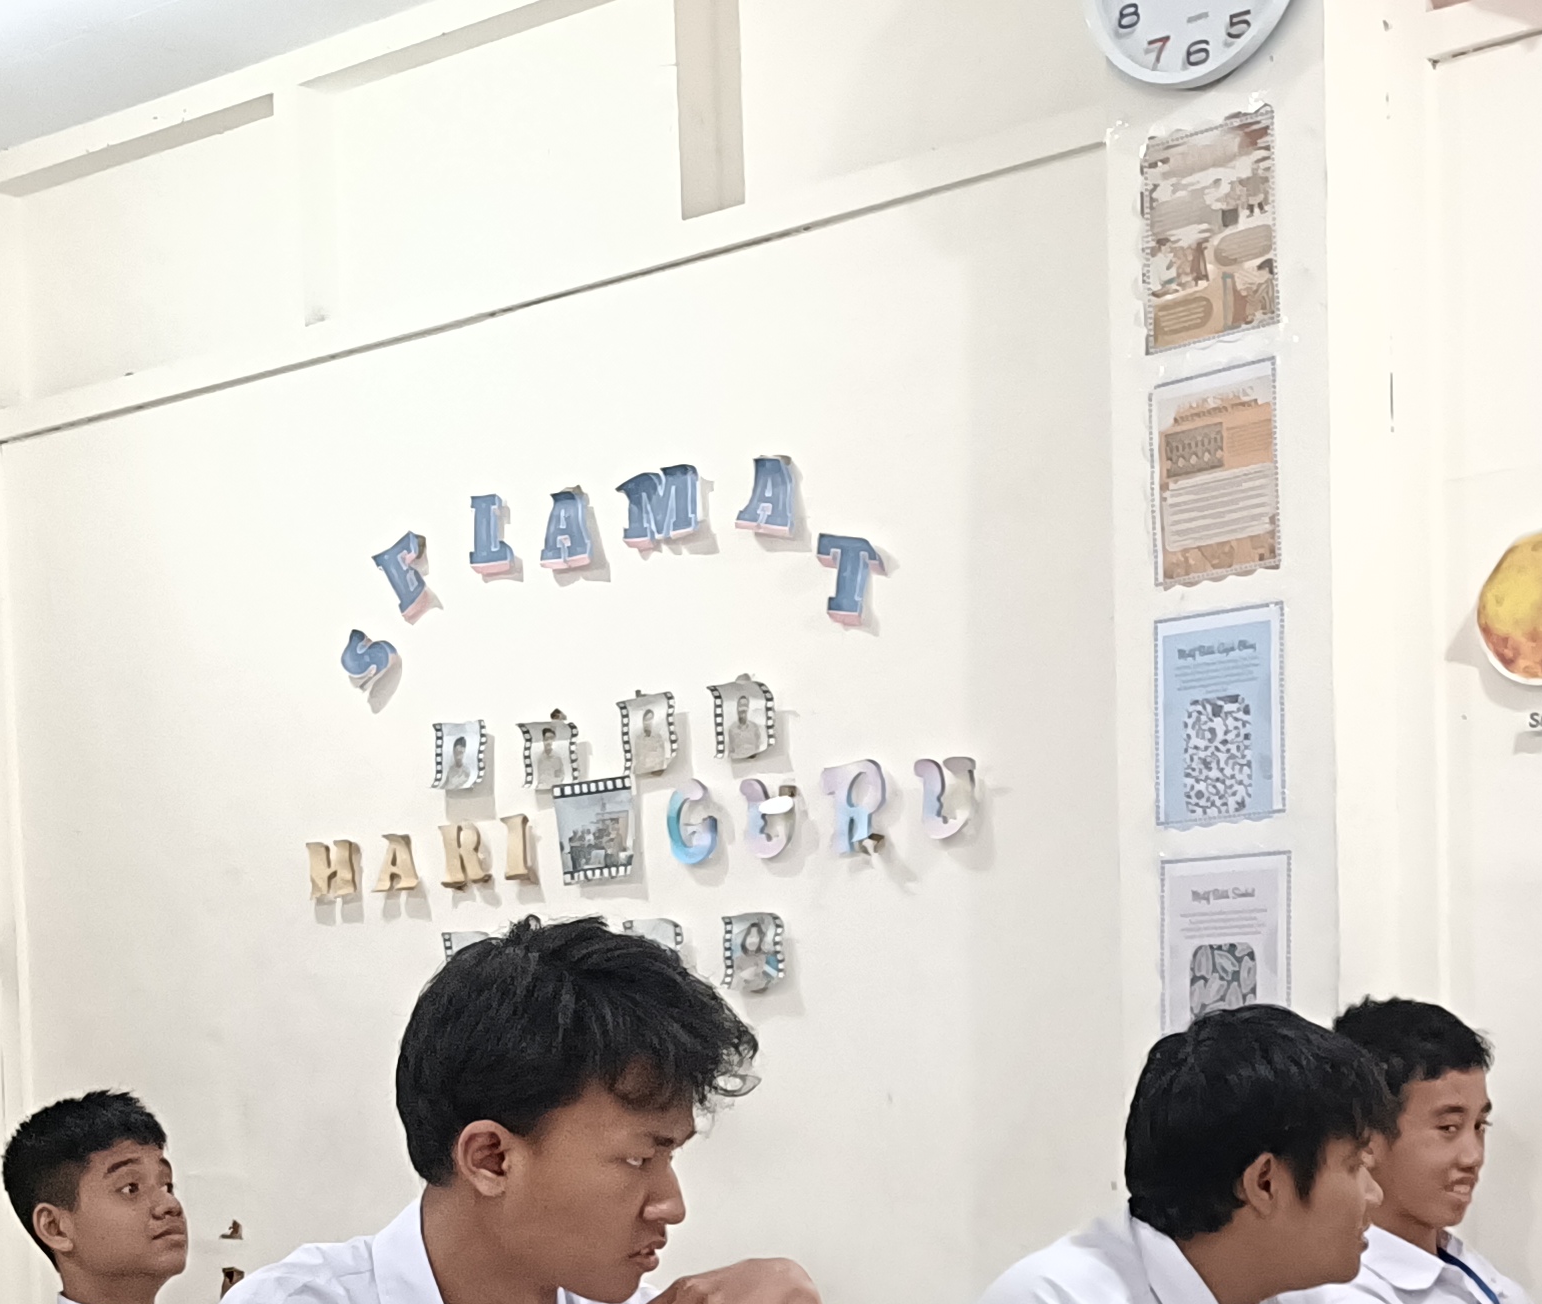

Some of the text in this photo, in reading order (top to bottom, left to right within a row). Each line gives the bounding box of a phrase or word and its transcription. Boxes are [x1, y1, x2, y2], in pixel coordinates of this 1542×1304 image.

[1117, 2, 1141, 30] 8
[1226, 8, 1252, 40] 5
[1146, 34, 1172, 65] 7
[1185, 38, 1211, 67] 6
[306, 757, 977, 899] HARI GURU
